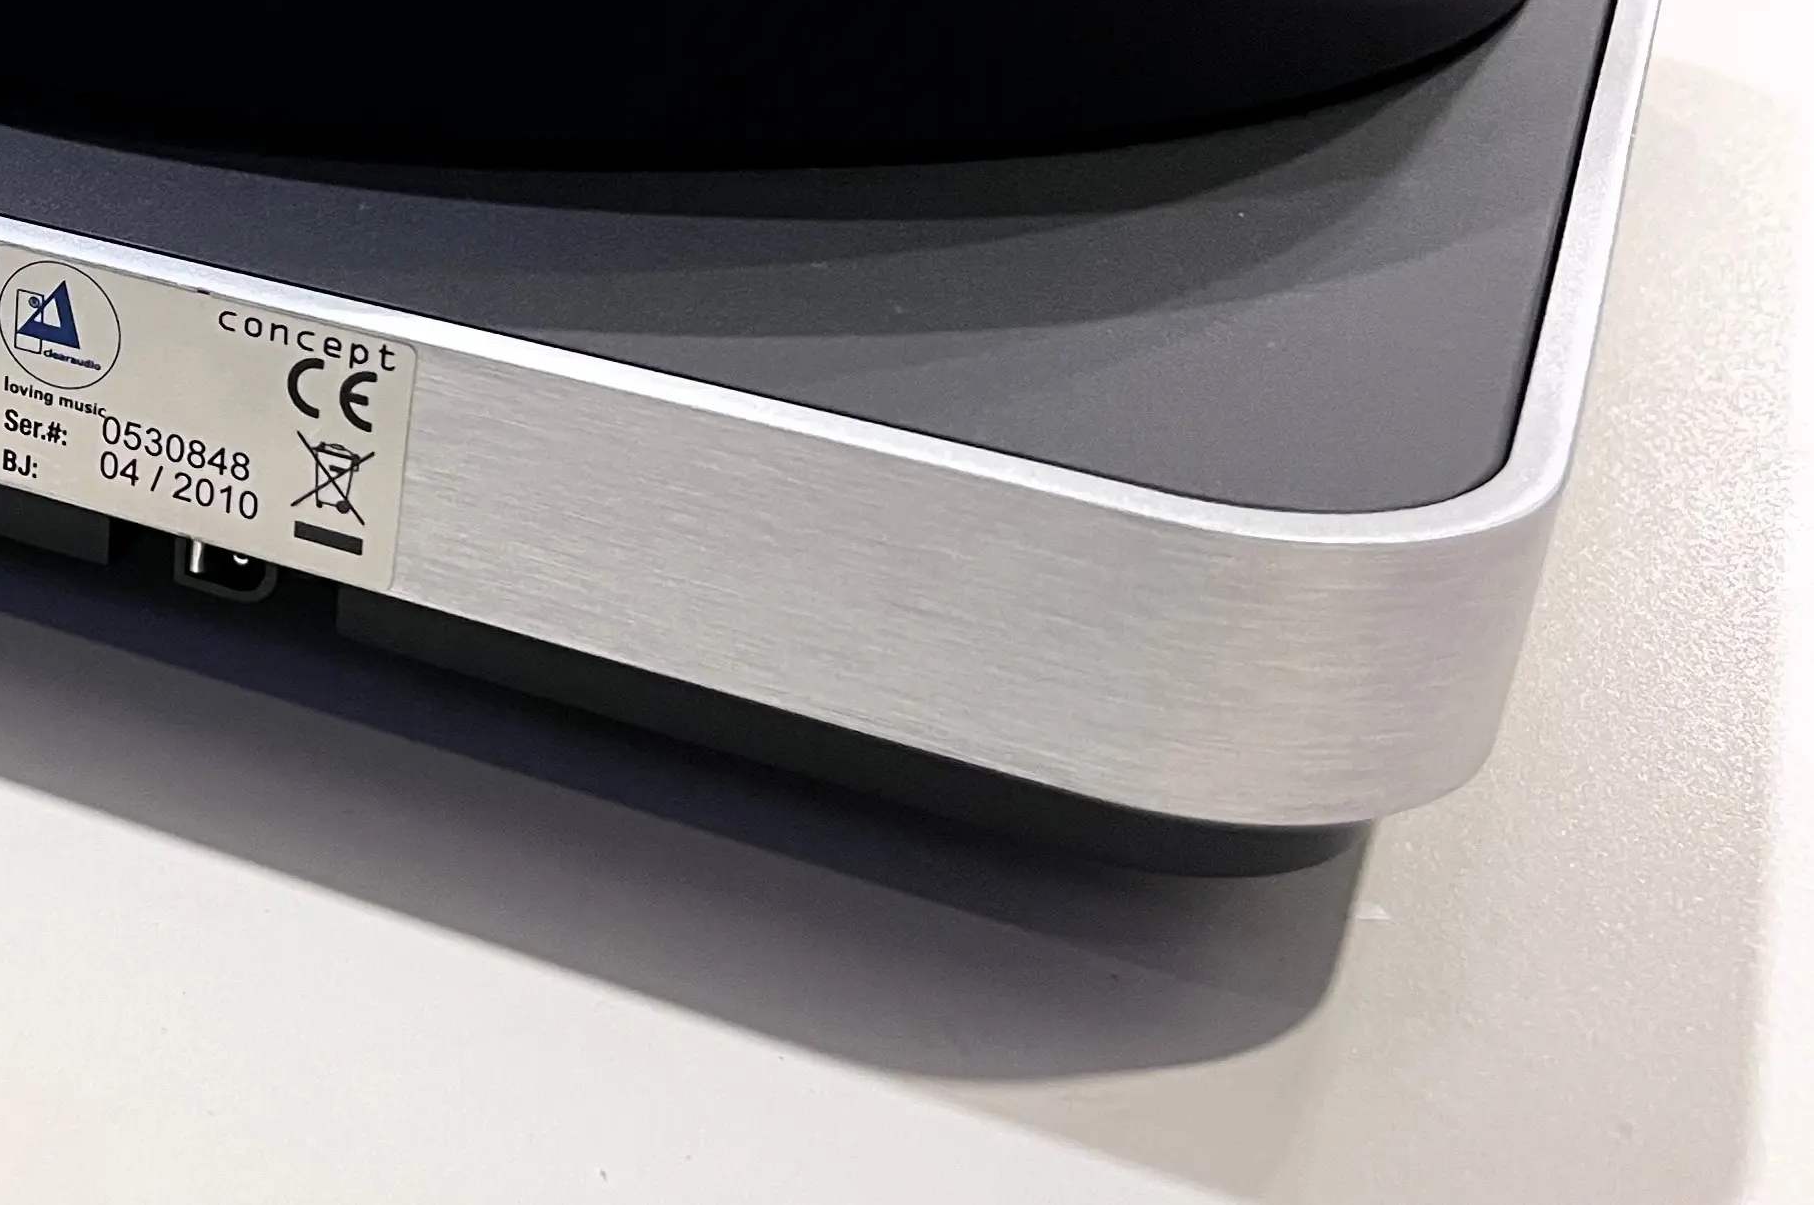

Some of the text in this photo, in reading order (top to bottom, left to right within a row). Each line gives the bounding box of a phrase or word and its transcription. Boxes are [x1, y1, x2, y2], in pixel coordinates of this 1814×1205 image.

[218, 310, 396, 371] concept
[4, 375, 107, 419] loving music
[287, 357, 378, 433] CE
[4, 408, 251, 481] Ser.#: 0530848
[2, 448, 38, 479] BJ:
[100, 451, 139, 487] 04
[172, 472, 259, 520] 2010
